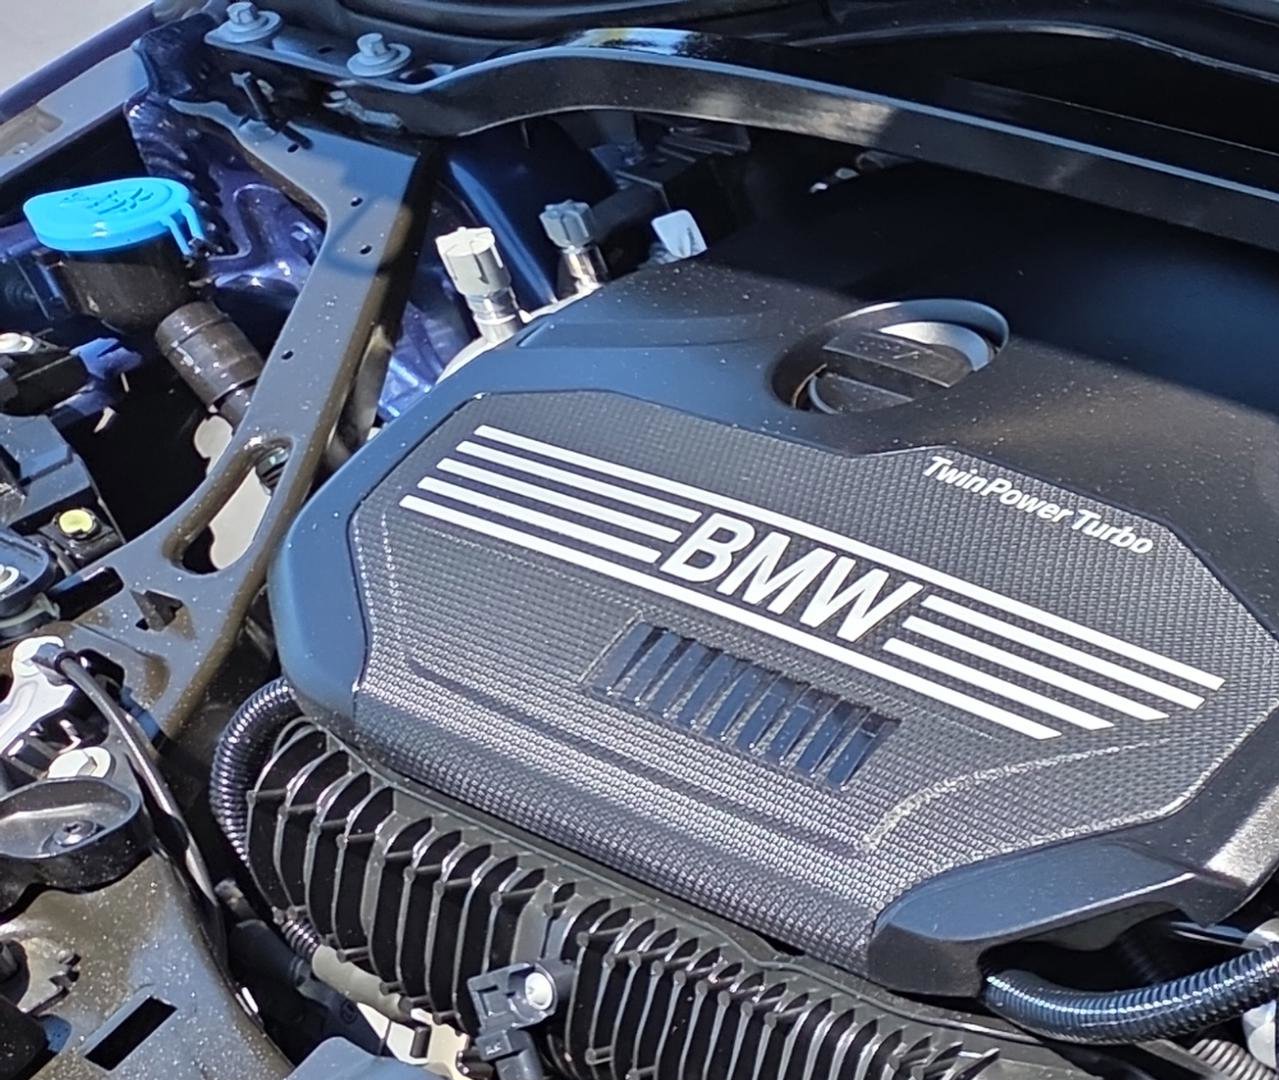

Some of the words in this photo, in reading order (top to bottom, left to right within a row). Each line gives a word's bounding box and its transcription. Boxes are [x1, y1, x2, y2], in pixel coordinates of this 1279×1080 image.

[923, 456, 1074, 523] TwinPower
[1071, 509, 1154, 554] Turbo
[659, 512, 924, 642] BMW
